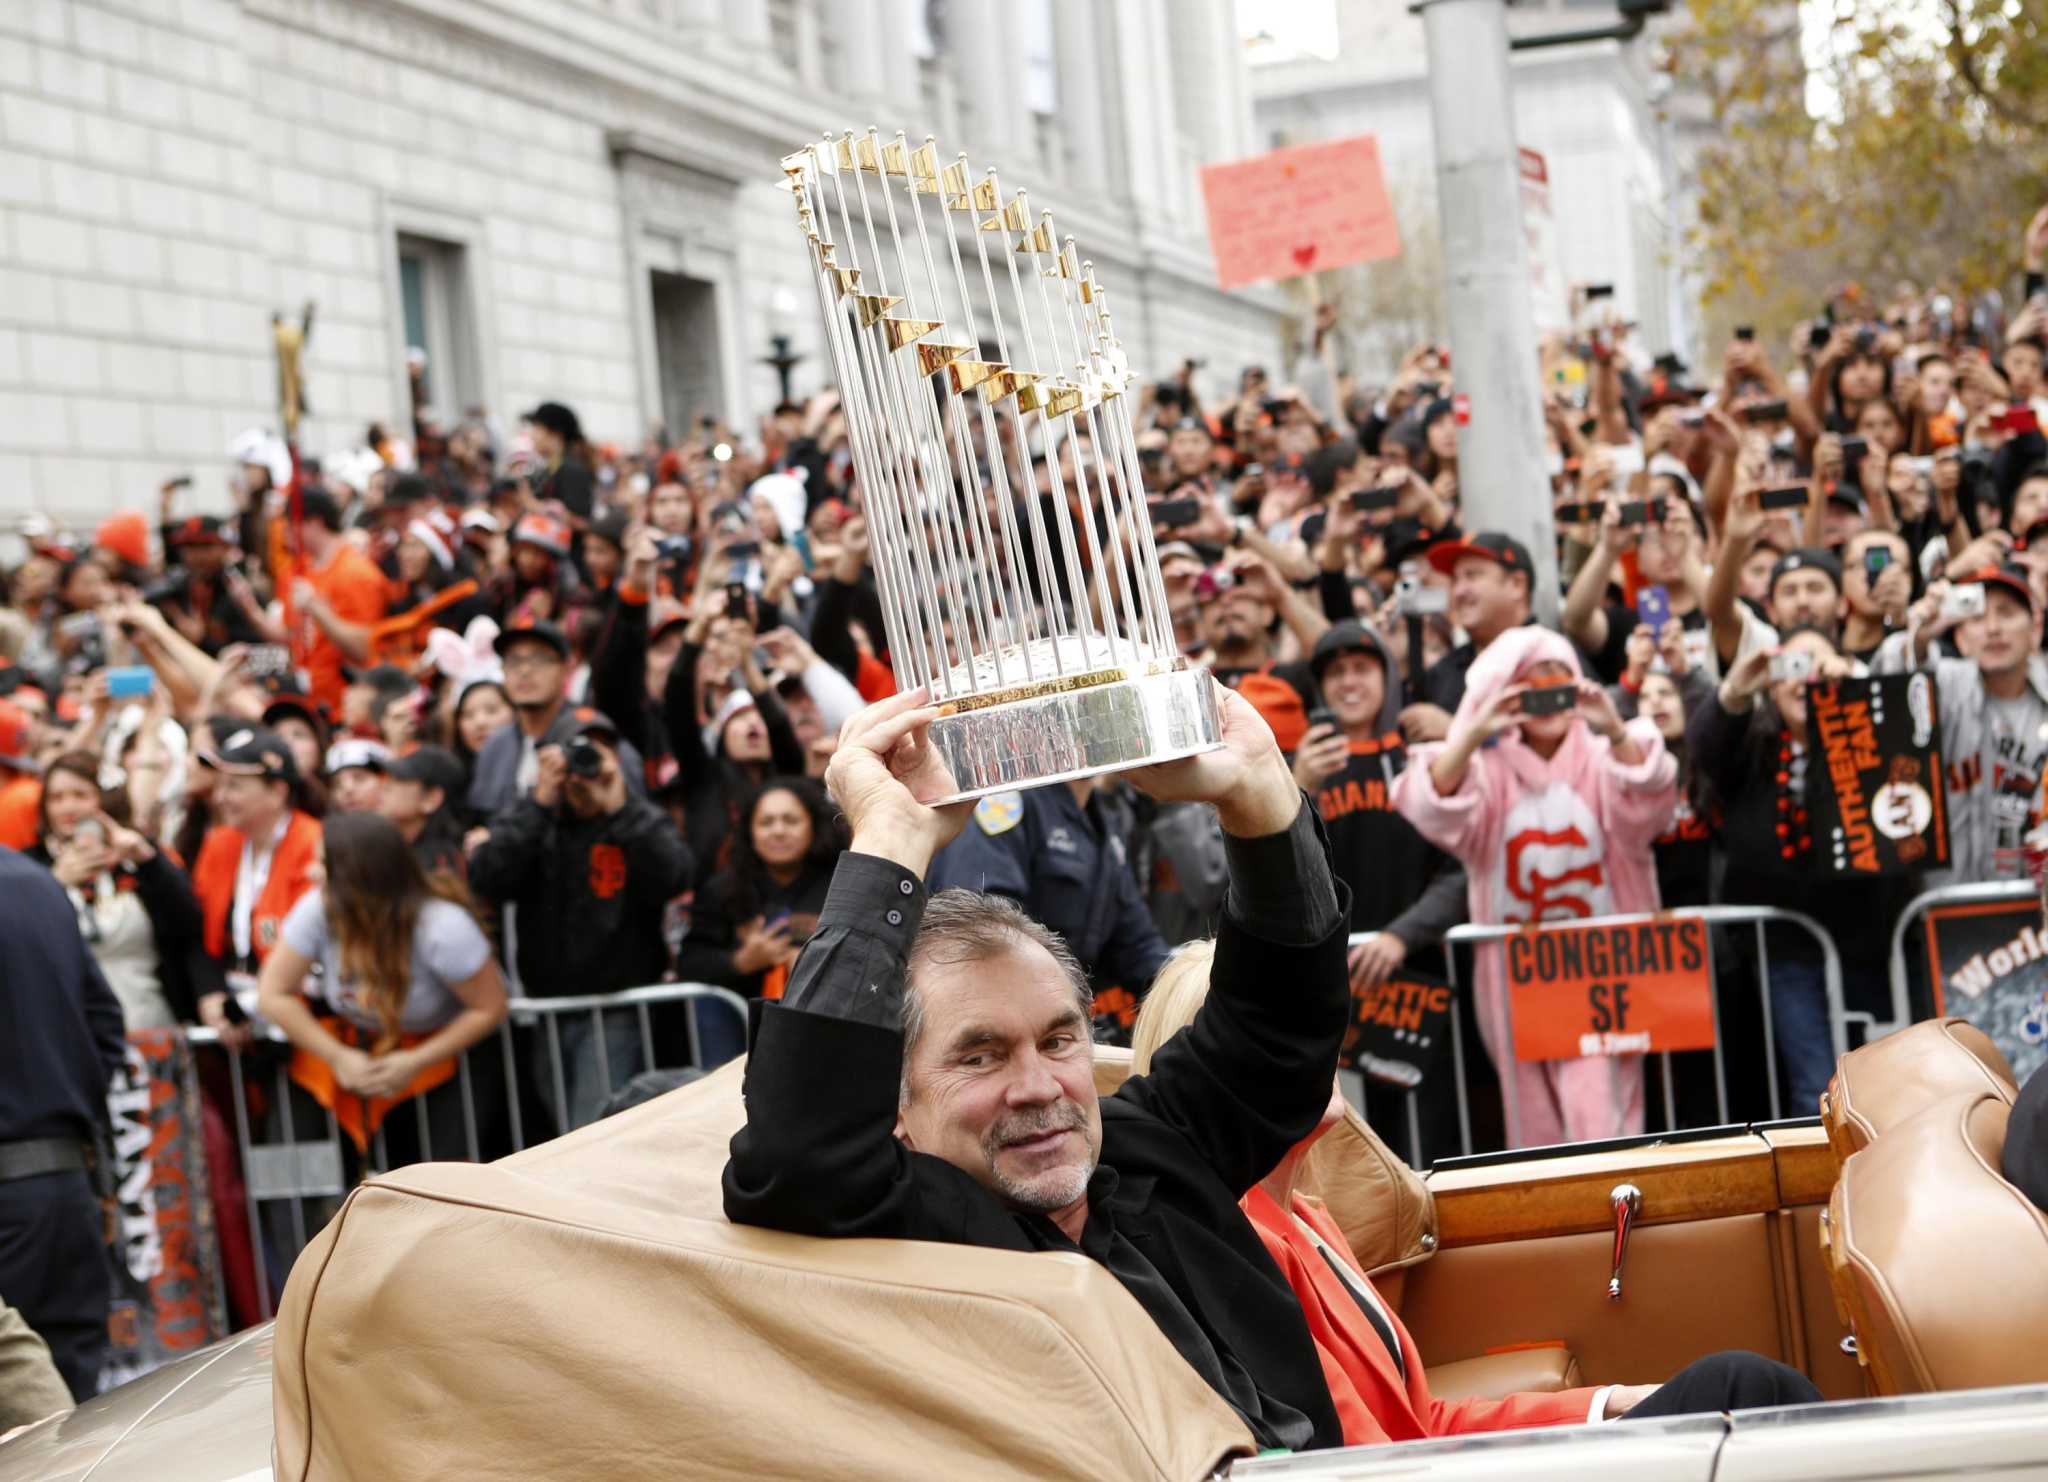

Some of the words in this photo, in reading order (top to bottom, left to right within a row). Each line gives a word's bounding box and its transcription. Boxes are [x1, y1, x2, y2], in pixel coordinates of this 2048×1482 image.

[1843, 700, 1883, 771] FAN
[1811, 685, 1881, 873] AUTHENTIC
[1510, 921, 1702, 985] CONGRATS
[1360, 1002, 1424, 1032] FAN
[1589, 983, 1631, 1032] SF
